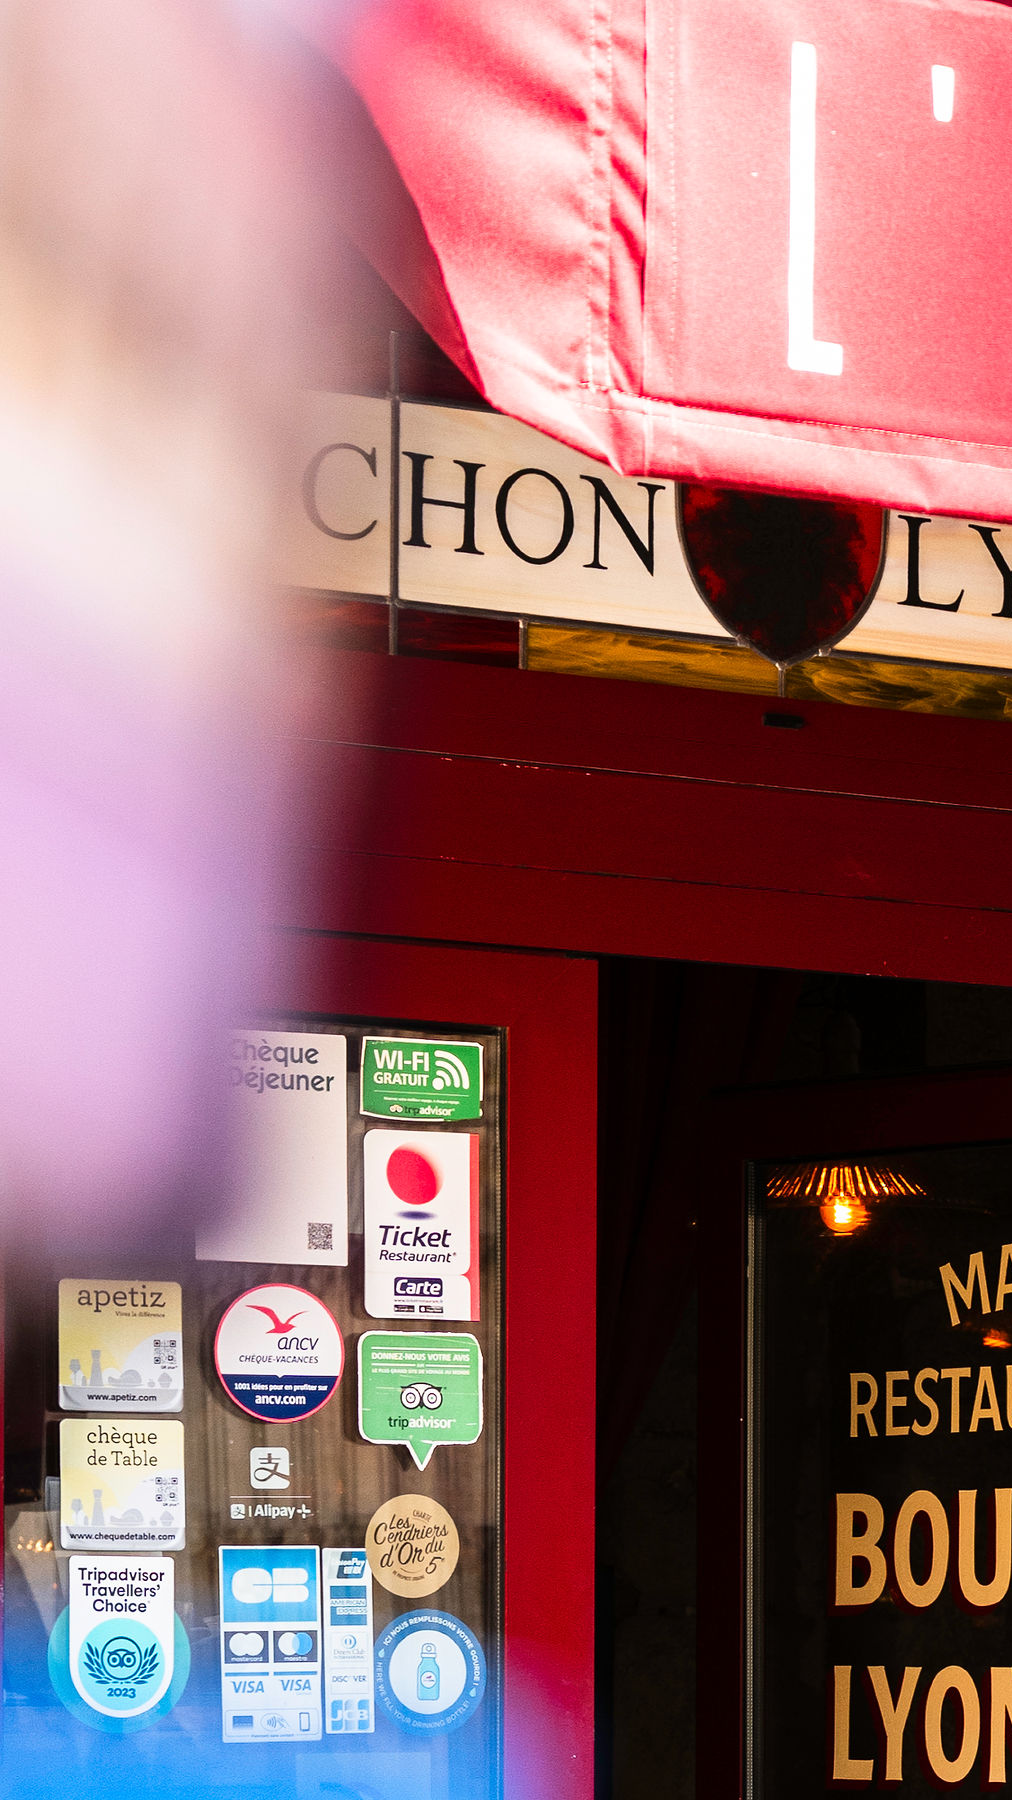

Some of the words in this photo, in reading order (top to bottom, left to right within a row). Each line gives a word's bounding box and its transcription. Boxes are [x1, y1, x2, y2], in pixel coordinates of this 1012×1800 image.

[373, 1048, 430, 1072] WI-FI
[373, 1071, 430, 1087] GRATUIT
[379, 1224, 452, 1249] Ticket
[395, 1278, 442, 1295] Carte
[78, 1284, 166, 1312] apetiz
[277, 1336, 319, 1351] ancv
[427, 1353, 451, 1361] VOTRE
[453, 1354, 470, 1362] AVIS
[87, 1393, 157, 1402] www.apetiz.com
[255, 1394, 307, 1405] ancv.com
[388, 1416, 452, 1430] tripadvisor
[87, 1425, 157, 1448] chèque
[87, 1449, 107, 1466] de
[111, 1449, 158, 1467] Table
[389, 1514, 410, 1530] Les
[69, 1532, 176, 1541] www.chequedetable.com
[374, 1522, 449, 1546] Cendriers
[380, 1542, 425, 1568] d'Or
[425, 1536, 445, 1555] du
[77, 1567, 165, 1584] Tripadvisor
[92, 1599, 148, 1613] Choice
[280, 1679, 312, 1691] VISA
[332, 1675, 367, 1683] DISCVER
[106, 1687, 136, 1699] 2023
[231, 1680, 265, 1694] VISA
